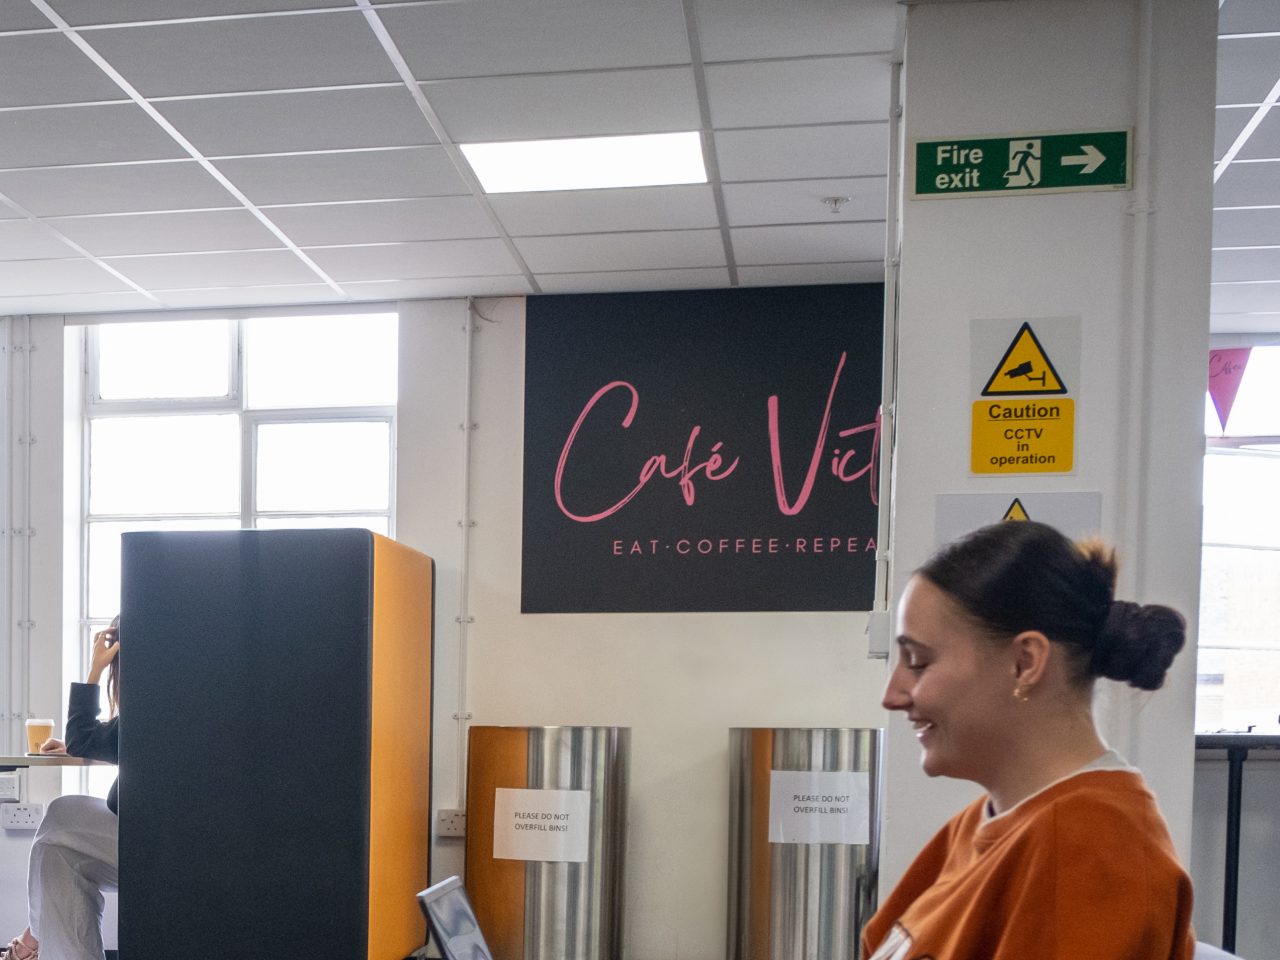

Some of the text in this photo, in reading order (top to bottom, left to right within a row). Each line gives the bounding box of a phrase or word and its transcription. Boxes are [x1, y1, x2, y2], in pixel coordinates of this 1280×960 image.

[936, 145, 983, 166] Fire
[935, 169, 980, 188] exit
[988, 404, 1060, 419] Caution
[1003, 428, 1044, 440] CCTV
[554, 380, 740, 523] Café
[1016, 442, 1030, 452] in
[990, 454, 1056, 466] operation
[793, 794, 820, 803] PLEASE
[821, 795, 833, 803] DO
[514, 812, 539, 820] PLEASE
[793, 806, 828, 814] OVERFILL
[514, 823, 568, 832] OVERFILL BINS!
